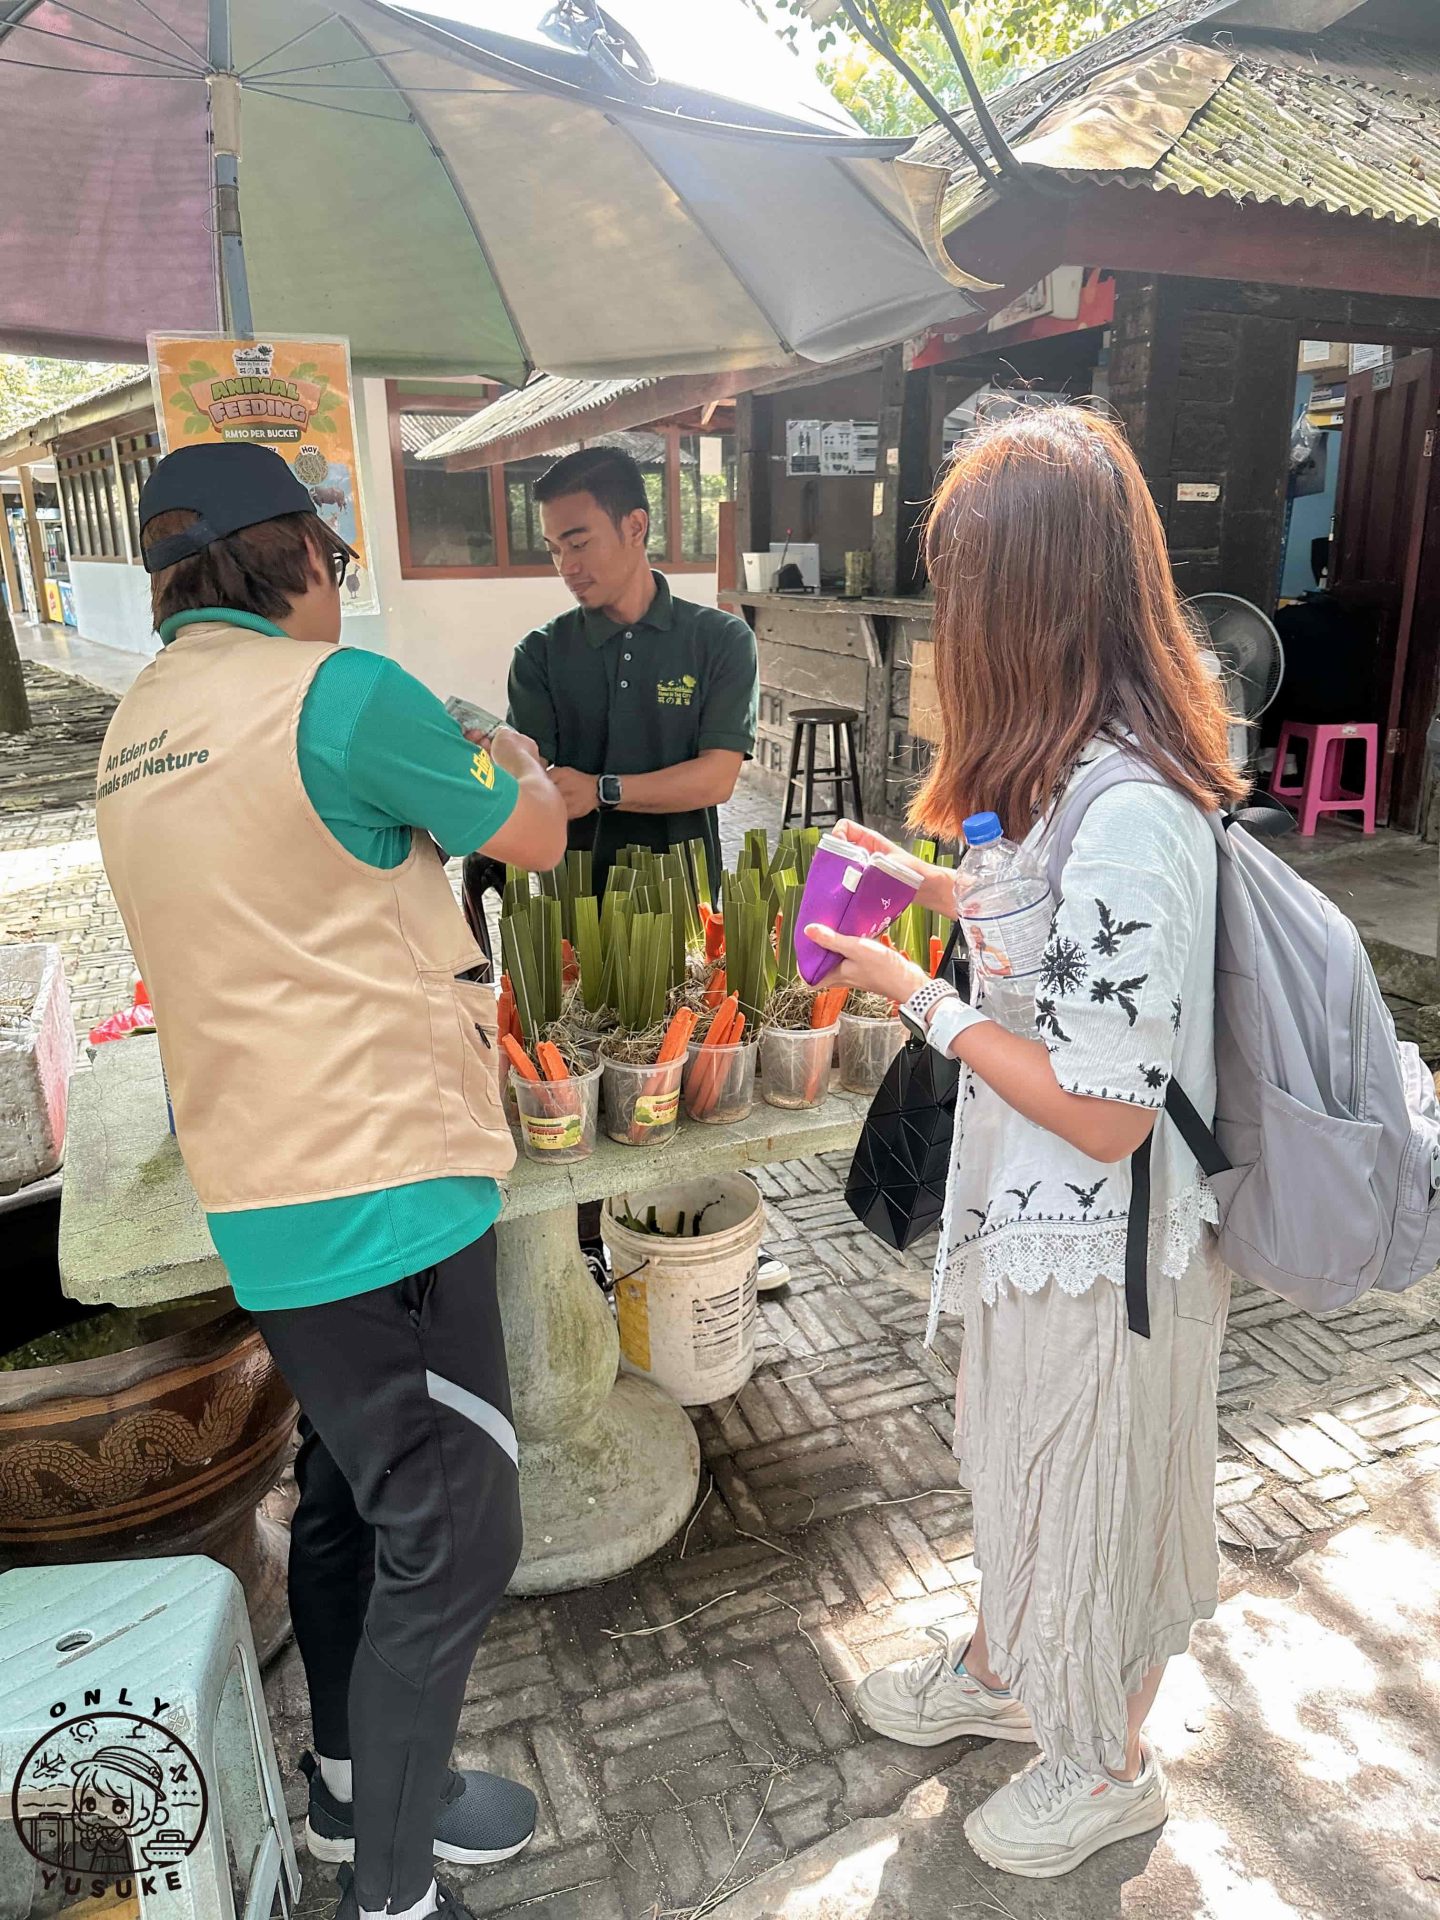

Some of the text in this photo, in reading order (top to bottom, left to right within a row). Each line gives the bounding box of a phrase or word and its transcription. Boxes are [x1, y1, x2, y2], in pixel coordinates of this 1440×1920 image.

[211, 377, 299, 400] ANIMAL
[209, 399, 307, 423] FEEDING
[225, 430, 298, 438] RM10 PER BUCKET
[301, 446, 318, 454] Hay
[105, 729, 169, 773] An Eden of
[121, 761, 142, 788] and
[142, 749, 210, 778] Nature
